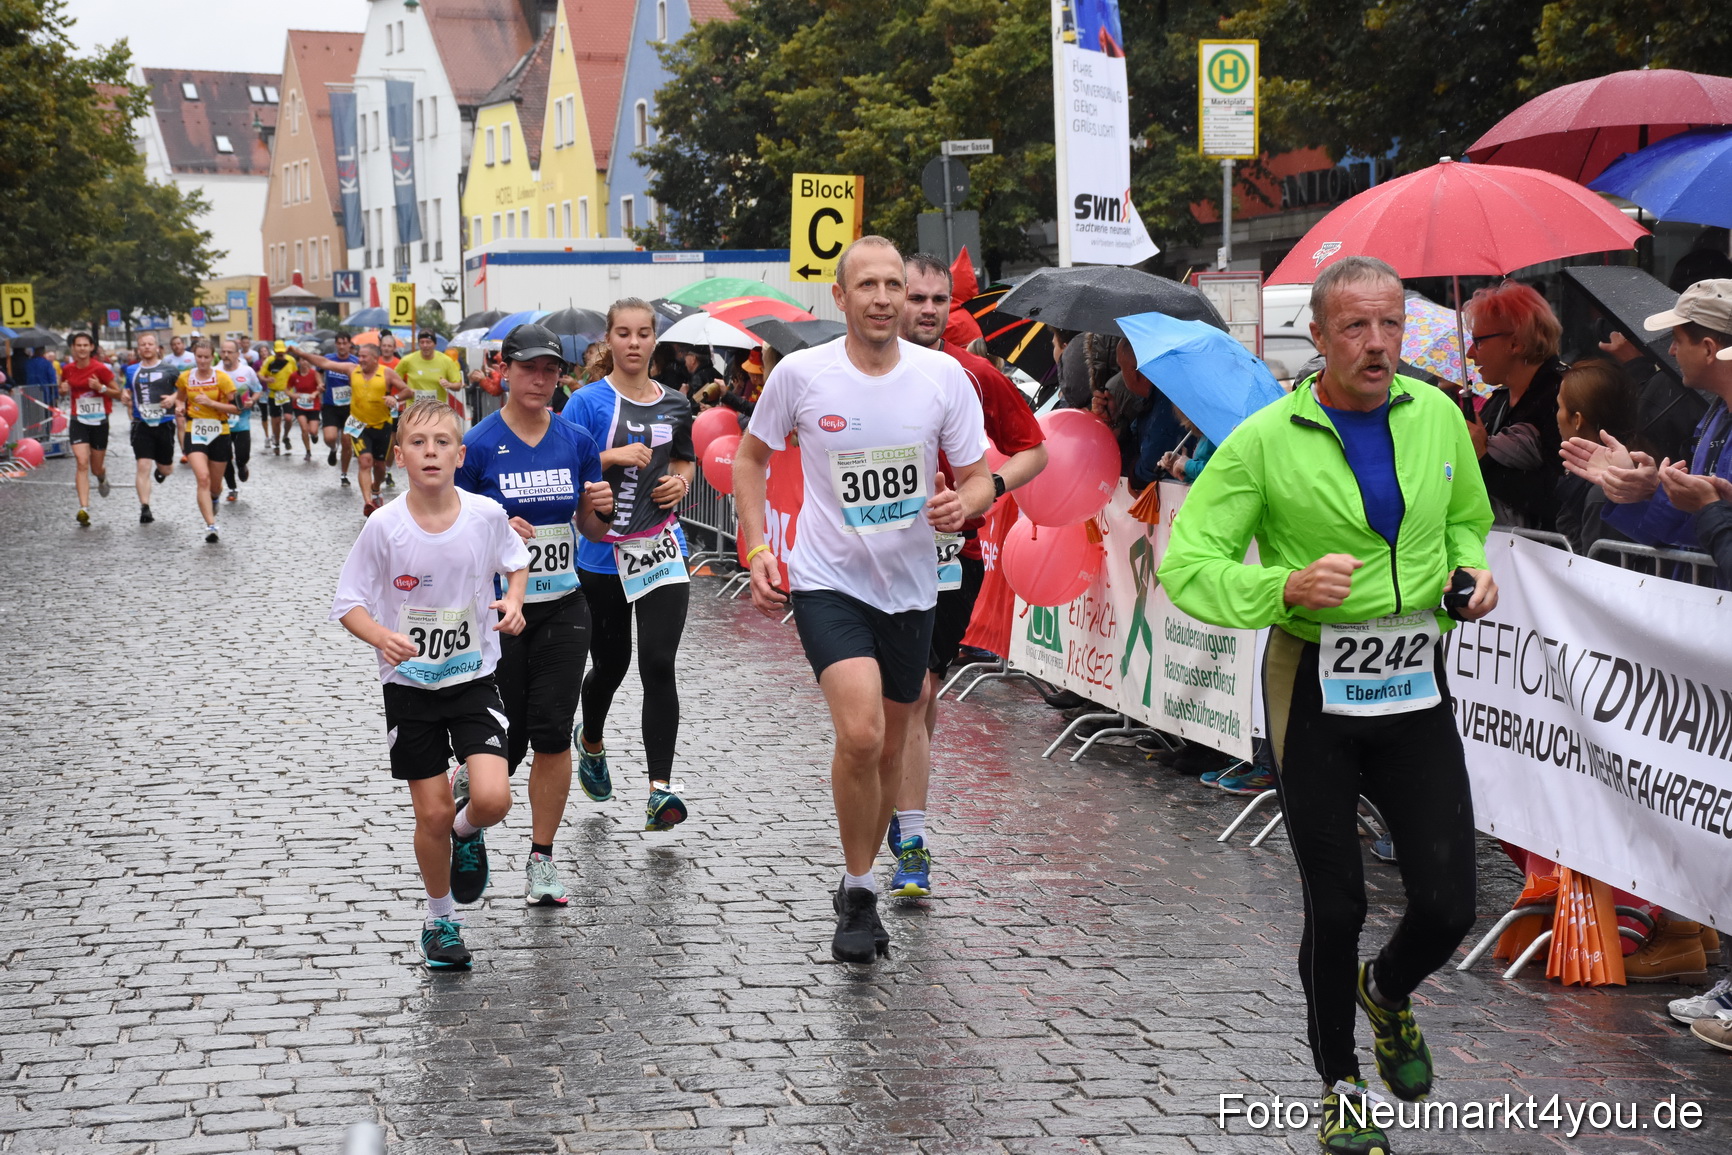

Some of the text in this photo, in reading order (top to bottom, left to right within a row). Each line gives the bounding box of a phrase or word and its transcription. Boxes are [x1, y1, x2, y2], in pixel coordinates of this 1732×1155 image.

[1211, 98, 1246, 106] Marktplatz
[951, 141, 991, 152] Ulmer Gasse
[801, 179, 855, 200] Block
[1074, 193, 1120, 222] swn
[808, 207, 844, 260] C
[4, 286, 29, 294] Block
[392, 284, 412, 293] Block
[10, 297, 26, 318] D
[395, 296, 409, 316] D
[79, 402, 101, 414] 3077
[821, 420, 845, 429] Hervis
[872, 447, 917, 460] BOCK
[499, 468, 573, 490] HUBER
[613, 420, 645, 526] HIMAEC
[517, 486, 572, 496] TECHNOLOGY
[841, 464, 918, 503] 3089
[518, 496, 537, 504] WASTE
[537, 495, 556, 503] WATER
[860, 502, 920, 523] KARL
[536, 527, 570, 538] BOCK
[528, 542, 570, 573] 289
[536, 579, 551, 591] Evi
[642, 567, 670, 587] Lorena
[1377, 614, 1423, 628] BOCK
[409, 621, 471, 660] 3093
[1332, 632, 1430, 674] 2242
[1163, 654, 1236, 696] Hausmeisterdienst
[1346, 680, 1412, 701] Eberhard
[1462, 699, 1586, 775] VERBRAUCH.
[1584, 738, 1629, 798] MEHR
